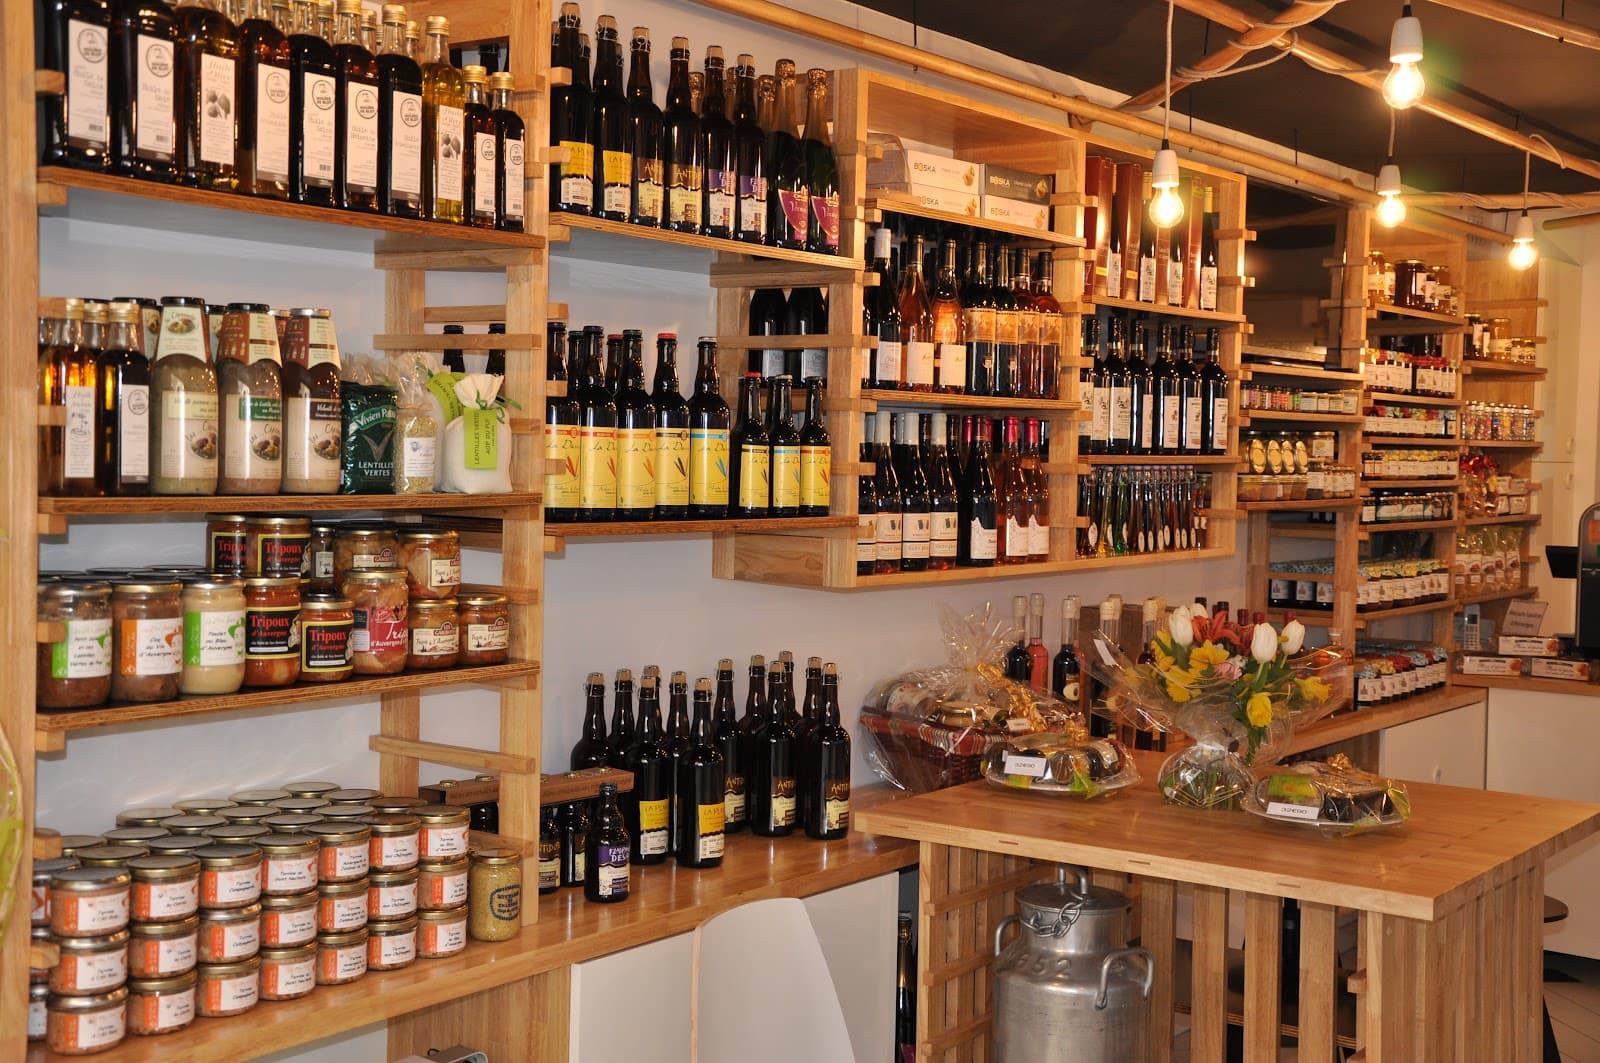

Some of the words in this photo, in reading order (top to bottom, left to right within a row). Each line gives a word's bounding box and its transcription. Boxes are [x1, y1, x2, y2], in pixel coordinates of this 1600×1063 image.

[914, 162, 936, 173] BOSKA
[989, 176, 1011, 186] BOSKA
[919, 195, 940, 206] OSKA
[356, 412, 381, 426] Vivien
[363, 469, 391, 477] VERTES
[265, 541, 302, 556] Tripoux
[249, 614, 289, 630] Tripoux
[309, 629, 347, 644] Tripoux
